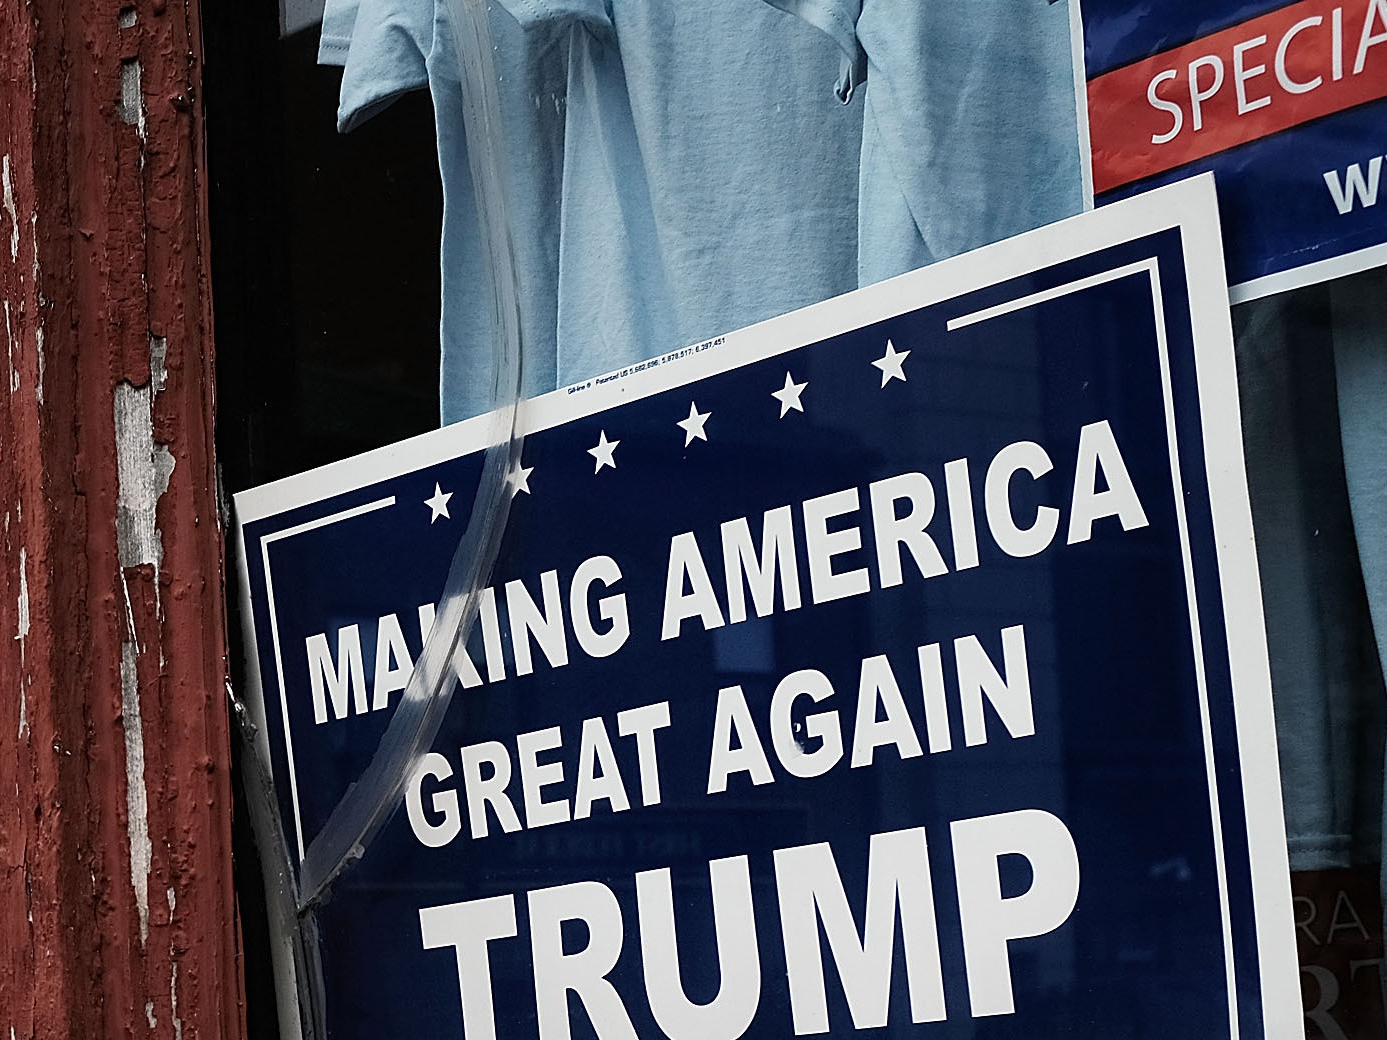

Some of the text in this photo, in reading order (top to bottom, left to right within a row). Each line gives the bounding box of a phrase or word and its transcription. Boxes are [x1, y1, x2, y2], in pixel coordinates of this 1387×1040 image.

[1323, 155, 1387, 215] W
[306, 420, 1149, 725] MAKING AMERICA
[402, 624, 1036, 849] GREAT AGAIN
